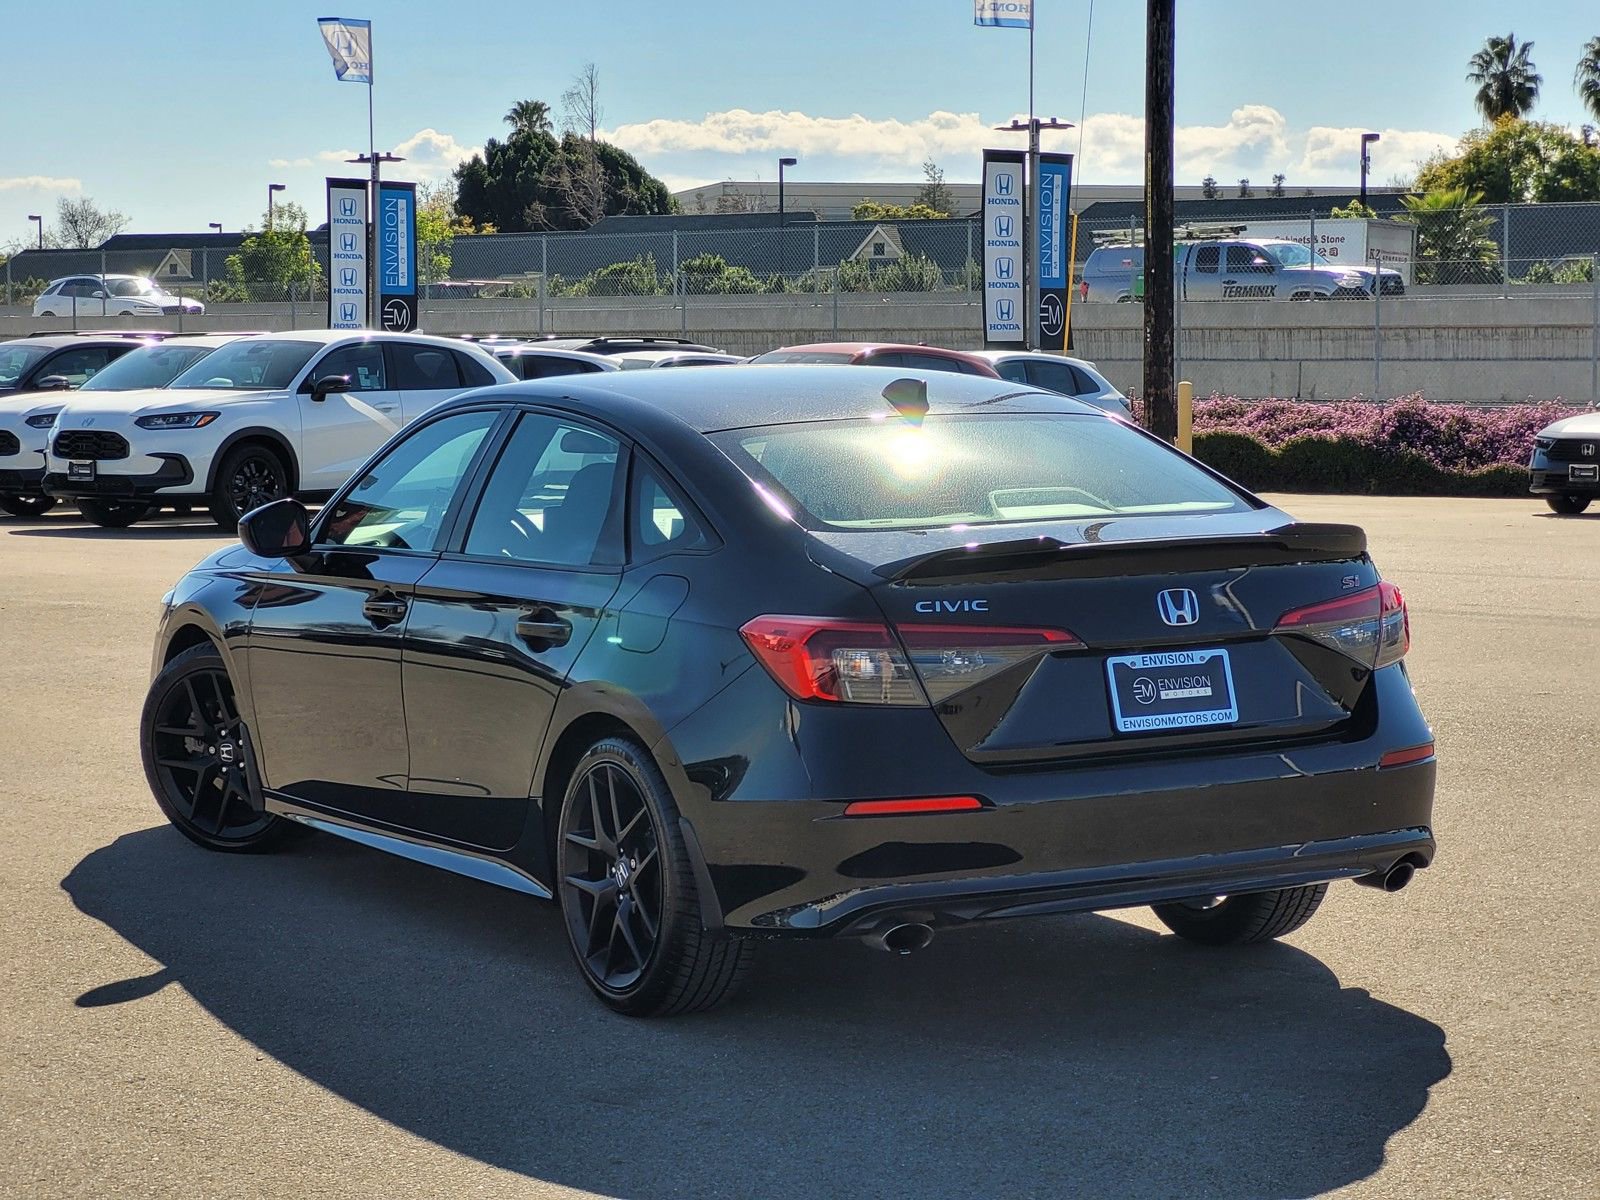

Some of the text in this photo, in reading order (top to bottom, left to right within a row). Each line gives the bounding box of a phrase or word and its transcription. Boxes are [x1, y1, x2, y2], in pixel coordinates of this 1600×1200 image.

[987, 198, 1020, 206] HONDA
[1042, 173, 1053, 278] ENVISION
[386, 198, 398, 286] ENVISION
[1321, 235, 1345, 244] Stone
[333, 287, 364, 295] HONDA
[1223, 284, 1277, 298] TERMINIX
[989, 323, 1020, 331] HONDA
[915, 600, 989, 612] CIVIC
[1141, 653, 1194, 666] ENVISION
[1157, 675, 1211, 691] ENVISION
[1164, 689, 1208, 697] MOTORS
[1123, 712, 1233, 729] ENVISIONMOTORS.COM
